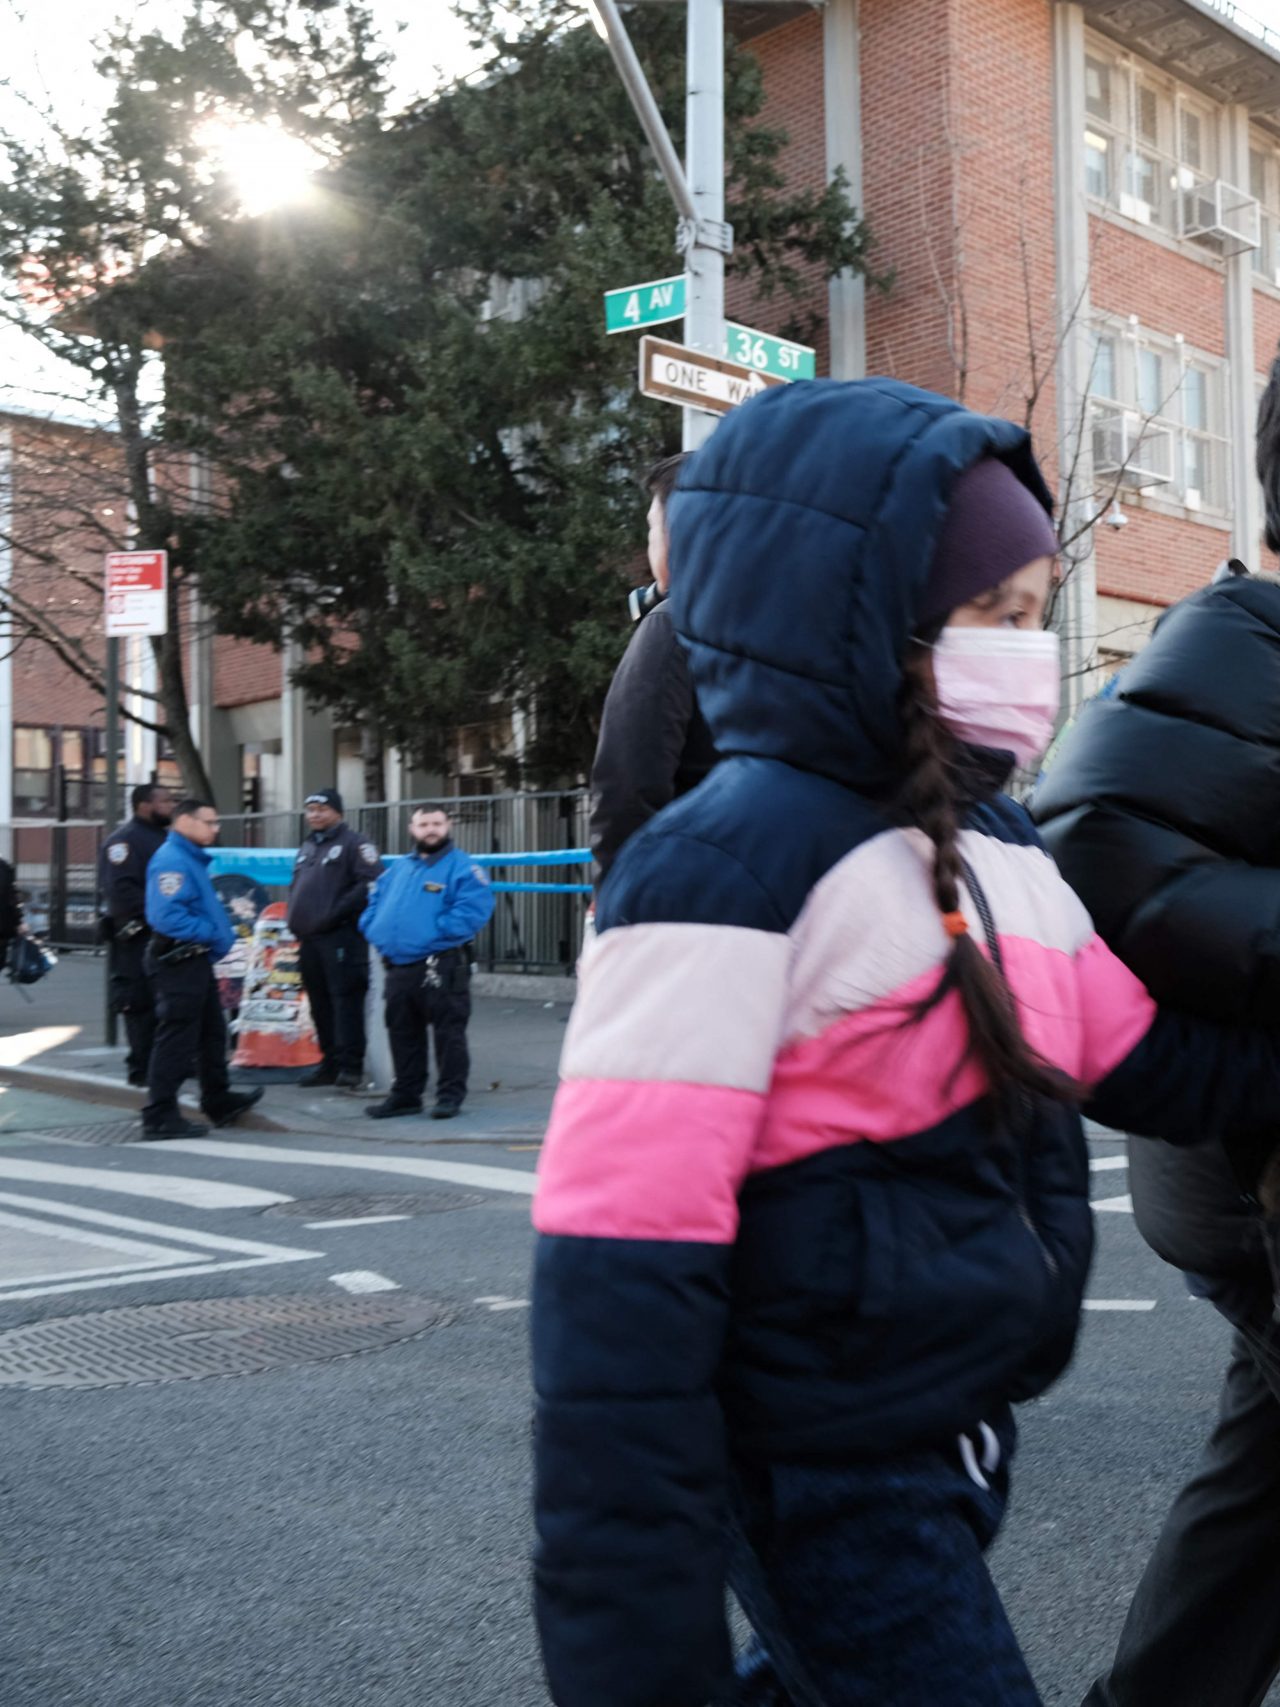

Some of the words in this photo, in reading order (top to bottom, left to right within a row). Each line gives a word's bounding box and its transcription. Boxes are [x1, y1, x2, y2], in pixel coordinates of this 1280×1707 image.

[624, 292, 641, 322] 4
[649, 284, 675, 310] AV
[737, 332, 768, 368] 36
[777, 345, 801, 370] ST
[665, 362, 707, 392] ONE
